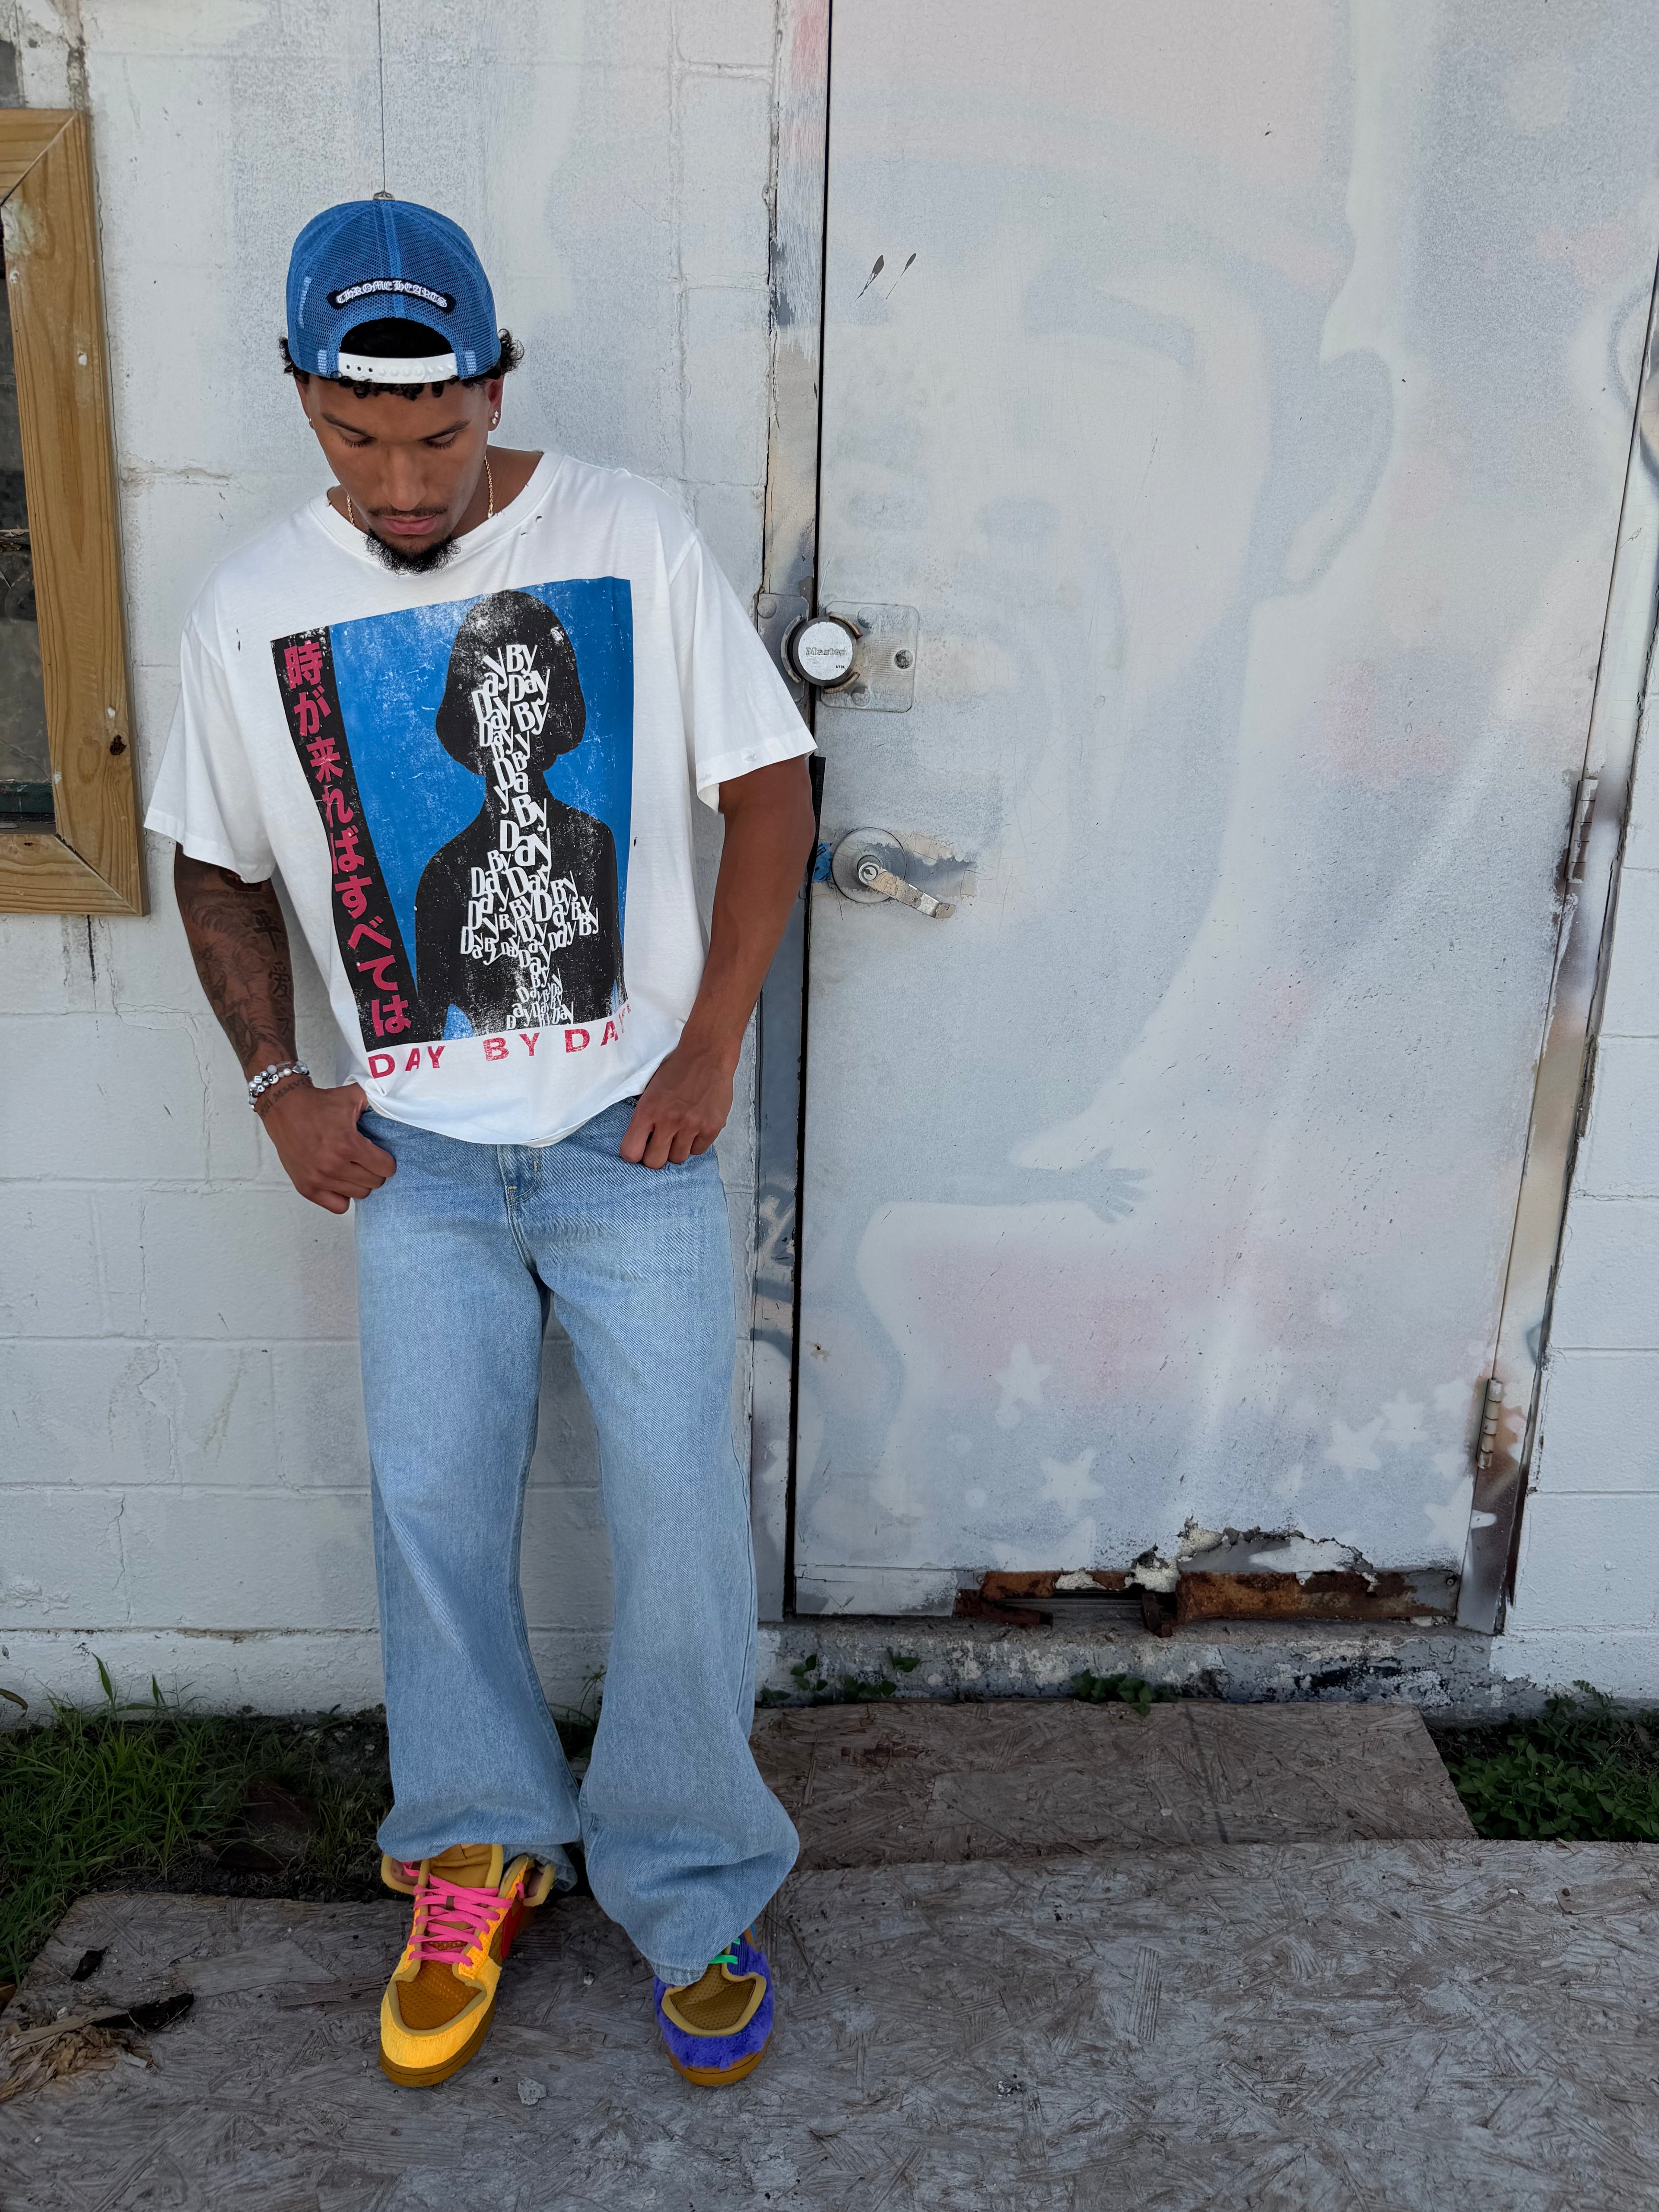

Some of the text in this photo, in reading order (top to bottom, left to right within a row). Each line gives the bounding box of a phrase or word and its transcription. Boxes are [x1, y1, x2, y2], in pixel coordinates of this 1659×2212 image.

[506, 644, 538, 674] By
[806, 647, 845, 656] Master
[471, 647, 508, 721] Day
[509, 669, 550, 706] Day
[513, 702, 550, 735] By
[512, 731, 531, 772] By
[512, 794, 547, 832] By
[487, 849, 511, 874] By
[500, 820, 551, 872] Day
[506, 866, 550, 898] Day
[550, 871, 578, 905] By
[509, 893, 533, 920] By
[572, 896, 593, 921] By
[579, 907, 599, 936] By
[499, 914, 518, 938] By
[548, 921, 576, 952] Day
[518, 942, 551, 975] Day
[531, 967, 550, 988] By
[368, 1045, 446, 1079] DAY
[483, 1032, 540, 1062] BY
